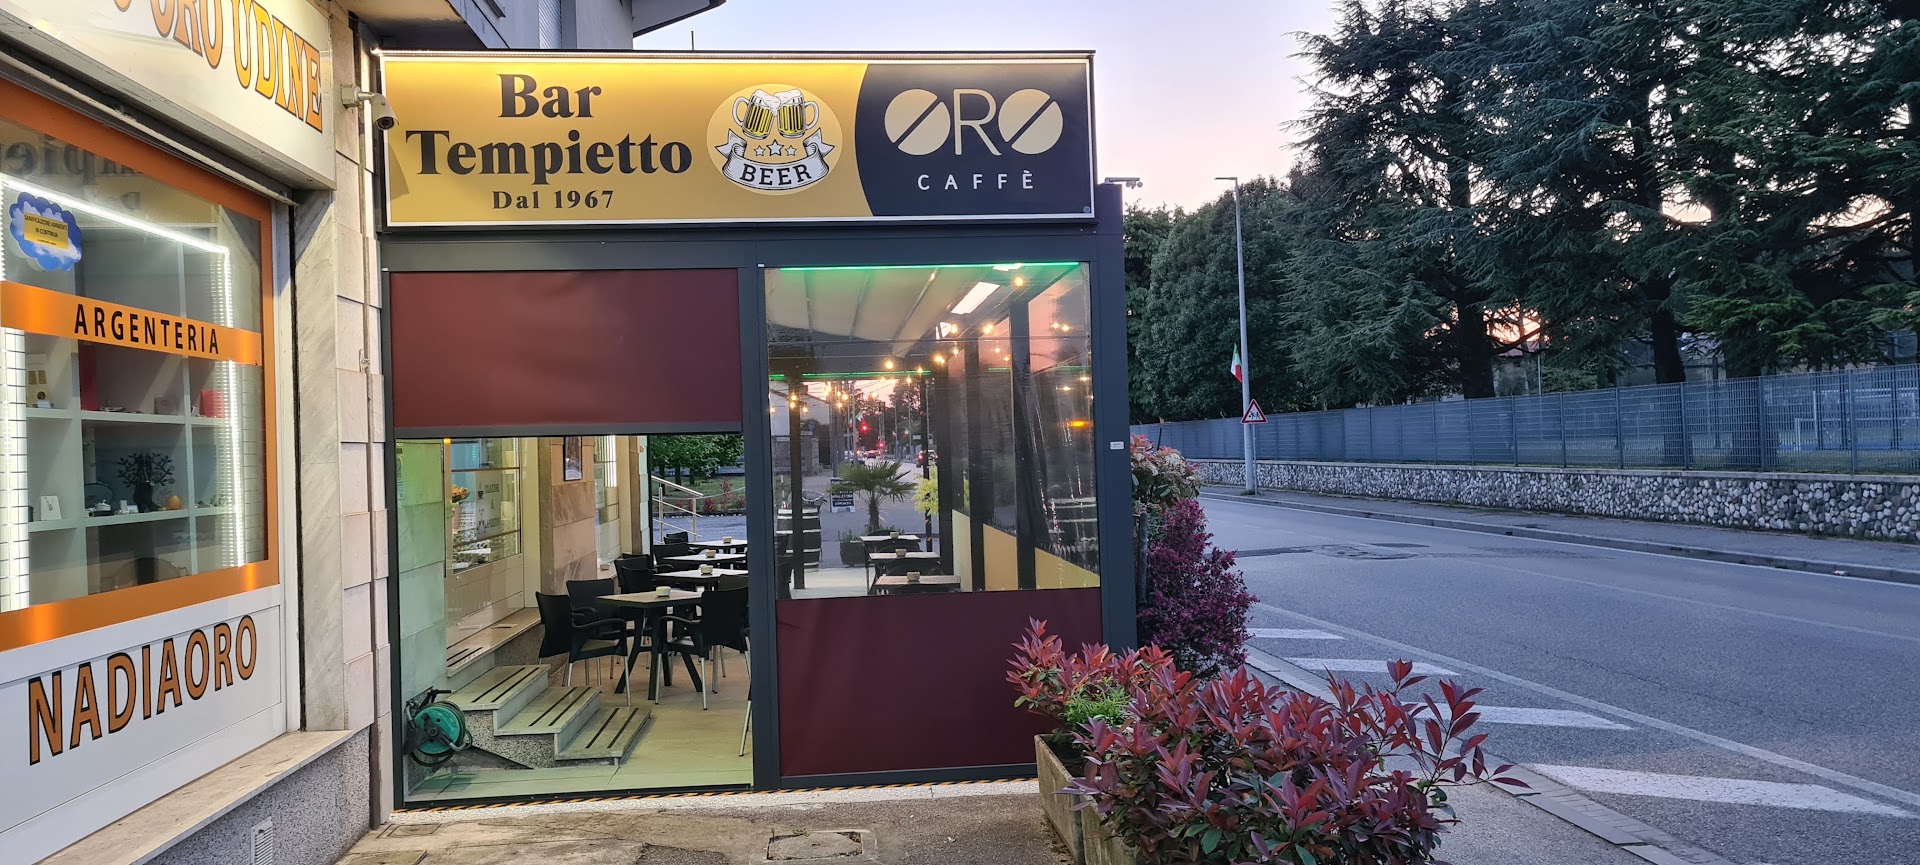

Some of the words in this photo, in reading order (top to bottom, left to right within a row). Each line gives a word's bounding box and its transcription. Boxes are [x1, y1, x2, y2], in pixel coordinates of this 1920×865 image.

[231, 0, 323, 134] UDINE
[496, 73, 602, 118] Bar
[884, 88, 1064, 156] ORO
[405, 129, 692, 185] Tempietto
[739, 163, 813, 186] BEER
[917, 169, 1034, 191] CAFFÈ
[24, 215, 51, 227] SANIFICAZIONE
[492, 190, 540, 209] Dal
[554, 190, 614, 209] 1967
[74, 303, 220, 355] ARGENTERIA
[29, 614, 257, 766] NADIAORO
